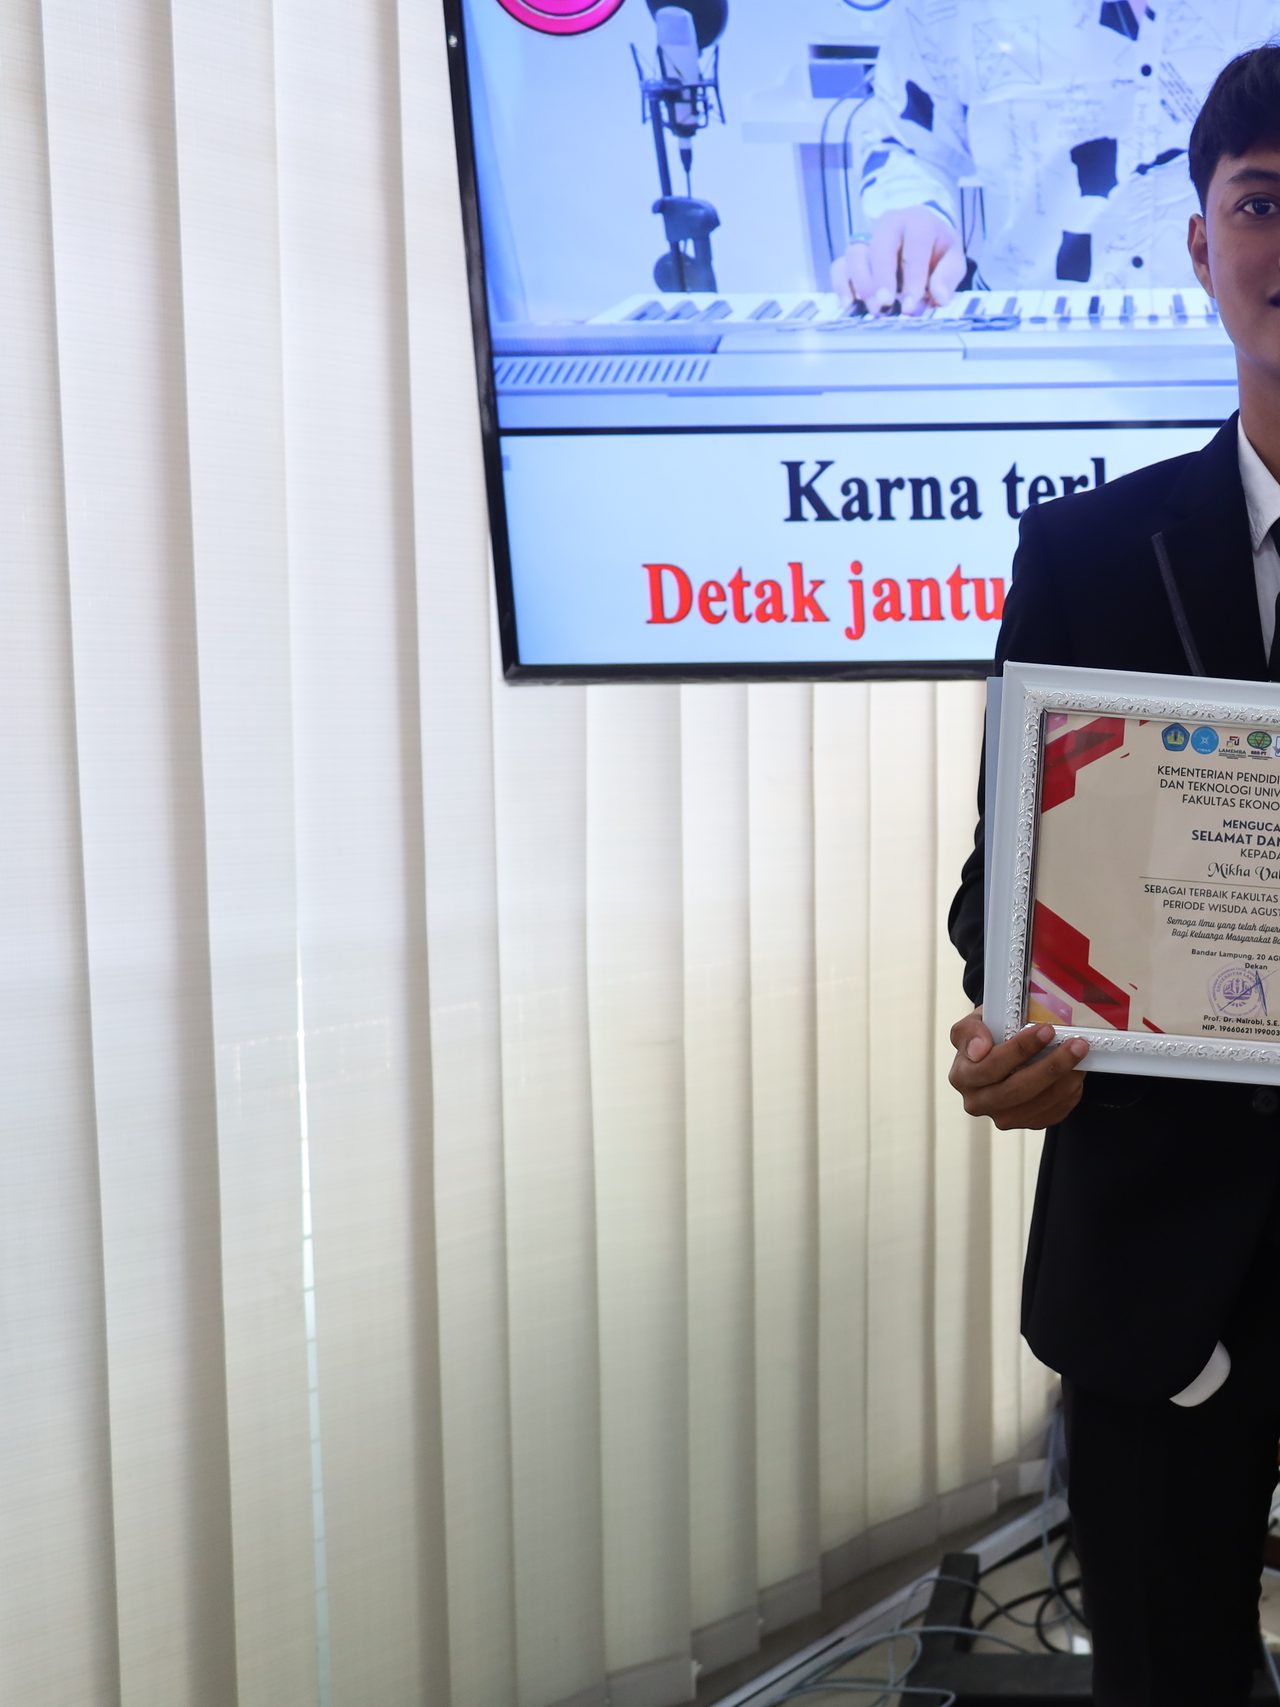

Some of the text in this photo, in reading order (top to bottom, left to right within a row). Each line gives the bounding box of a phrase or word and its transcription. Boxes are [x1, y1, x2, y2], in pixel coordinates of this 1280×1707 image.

[780, 460, 983, 522] Karna
[642, 562, 830, 624] Detak
[1157, 765, 1234, 781] KEMENTERIAN
[1160, 778, 1185, 791] DAN
[1188, 781, 1251, 796] TEKNOLOGI
[1182, 794, 1236, 808] FAKULTAS
[1191, 829, 1253, 845] SELAMAT
[1207, 861, 1251, 879] Mikha
[1144, 884, 1186, 896] SEBAGAI
[1189, 887, 1228, 900] TERBAIK
[1231, 891, 1279, 904] FAKULTAS
[1163, 899, 1205, 912] PERIODE
[1208, 903, 1248, 915] WISUDA
[1166, 916, 1196, 927] Semoga
[1216, 921, 1236, 931] yang
[1238, 922, 1257, 931] telah
[1171, 928, 1188, 938] Bagi
[1189, 930, 1224, 941] Keluarga
[1225, 933, 1271, 944] Masyarakat
[1191, 948, 1217, 957] Bandar
[1244, 962, 1268, 970] Dekan
[1203, 1014, 1220, 1022] Prof.
[1219, 1025, 1253, 1034] 19660621
